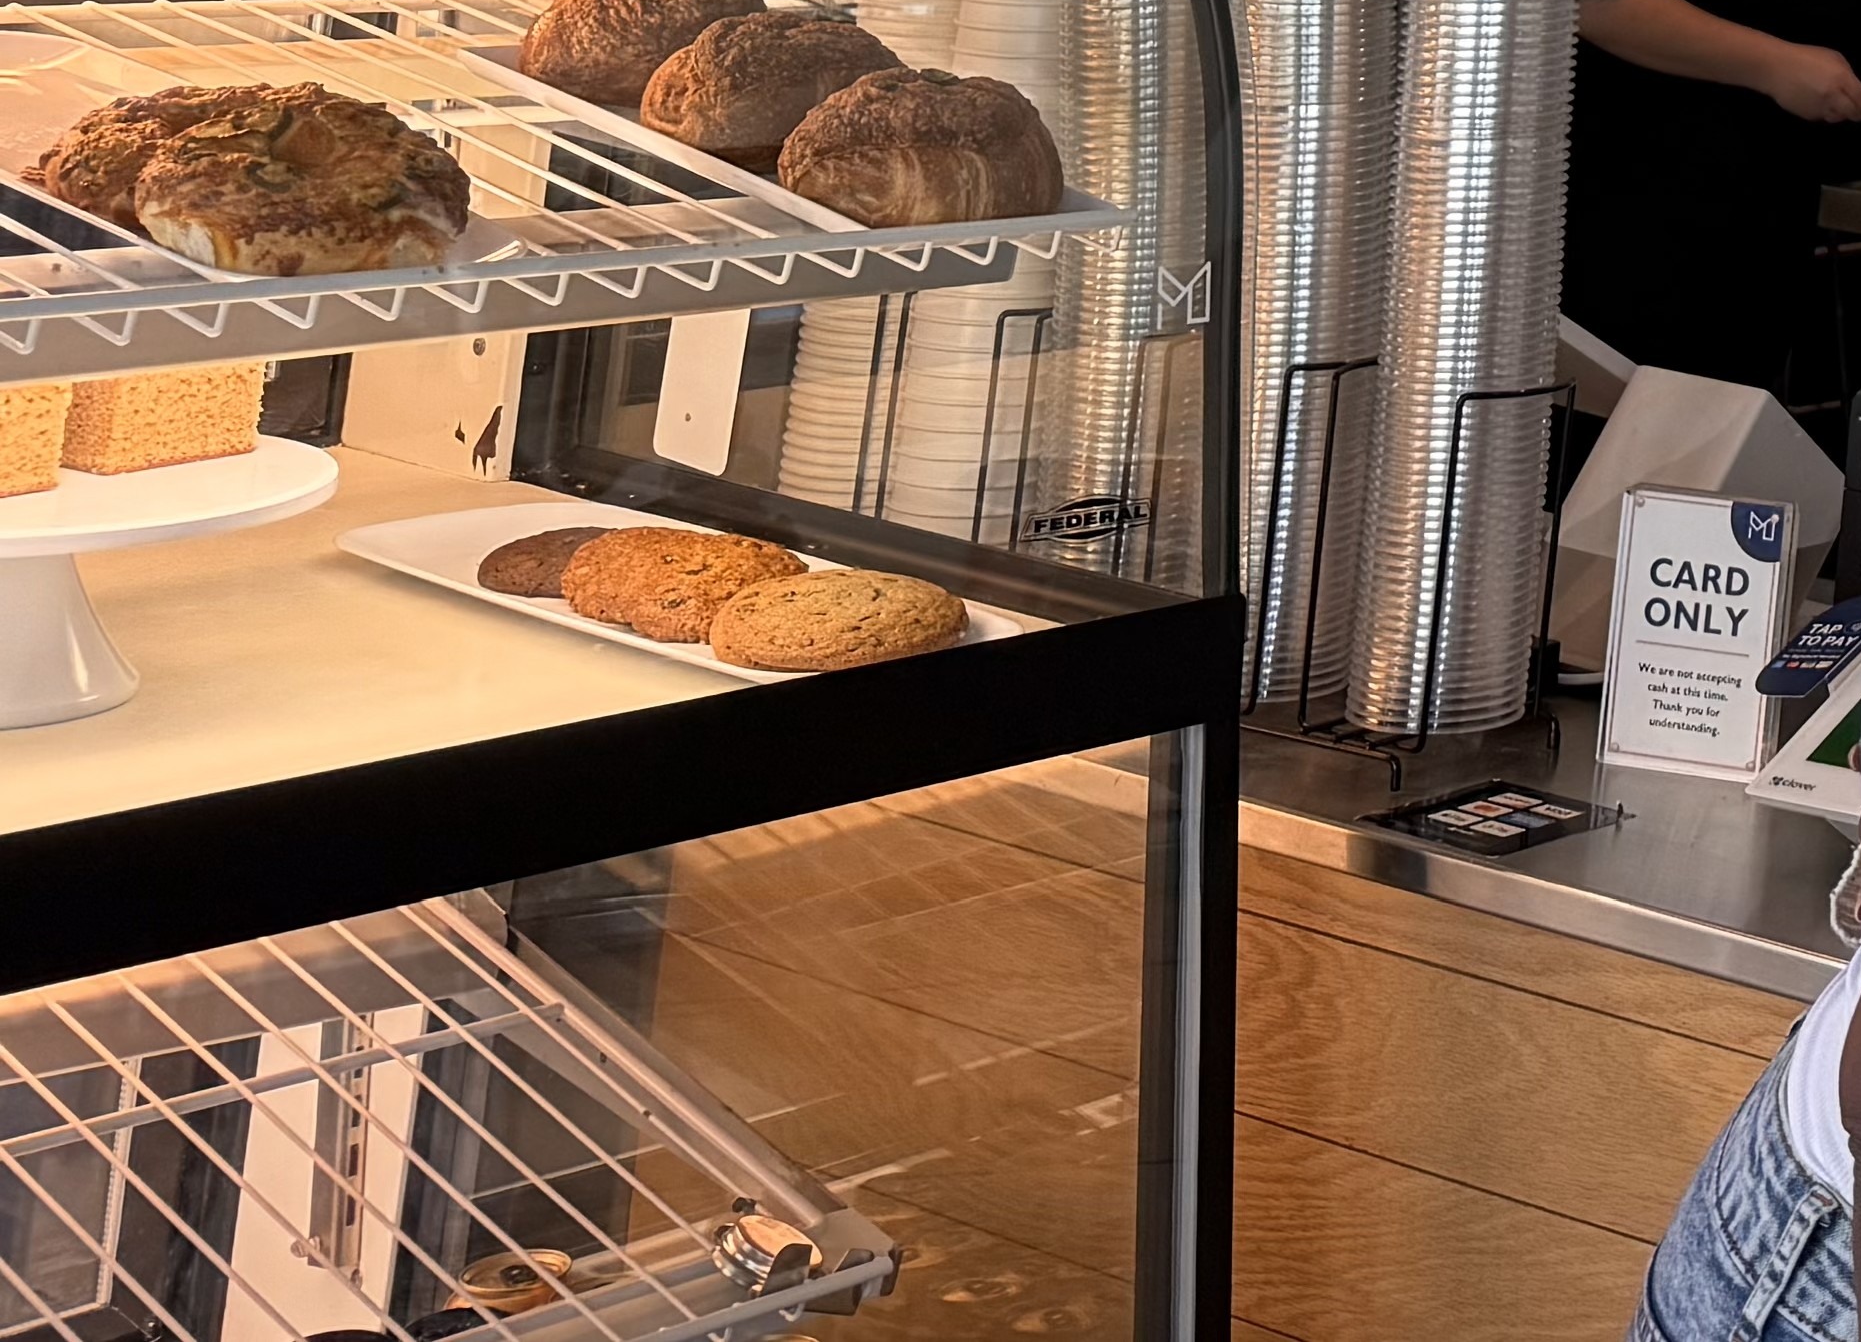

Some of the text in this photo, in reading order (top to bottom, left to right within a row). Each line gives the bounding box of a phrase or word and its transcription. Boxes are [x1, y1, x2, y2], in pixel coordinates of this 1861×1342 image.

[1034, 505, 1148, 534] FEDERAL
[1650, 557, 1750, 596] CARD
[1644, 597, 1749, 637] ONLY
[1809, 623, 1843, 634] TAP
[1798, 636, 1860, 647] TO PAY
[1638, 662, 1656, 675] We
[1658, 667, 1675, 677] are
[1677, 669, 1694, 680] not
[1647, 682, 1668, 694] cash
[1683, 686, 1701, 699] this
[1653, 698, 1720, 718] Thank you for
